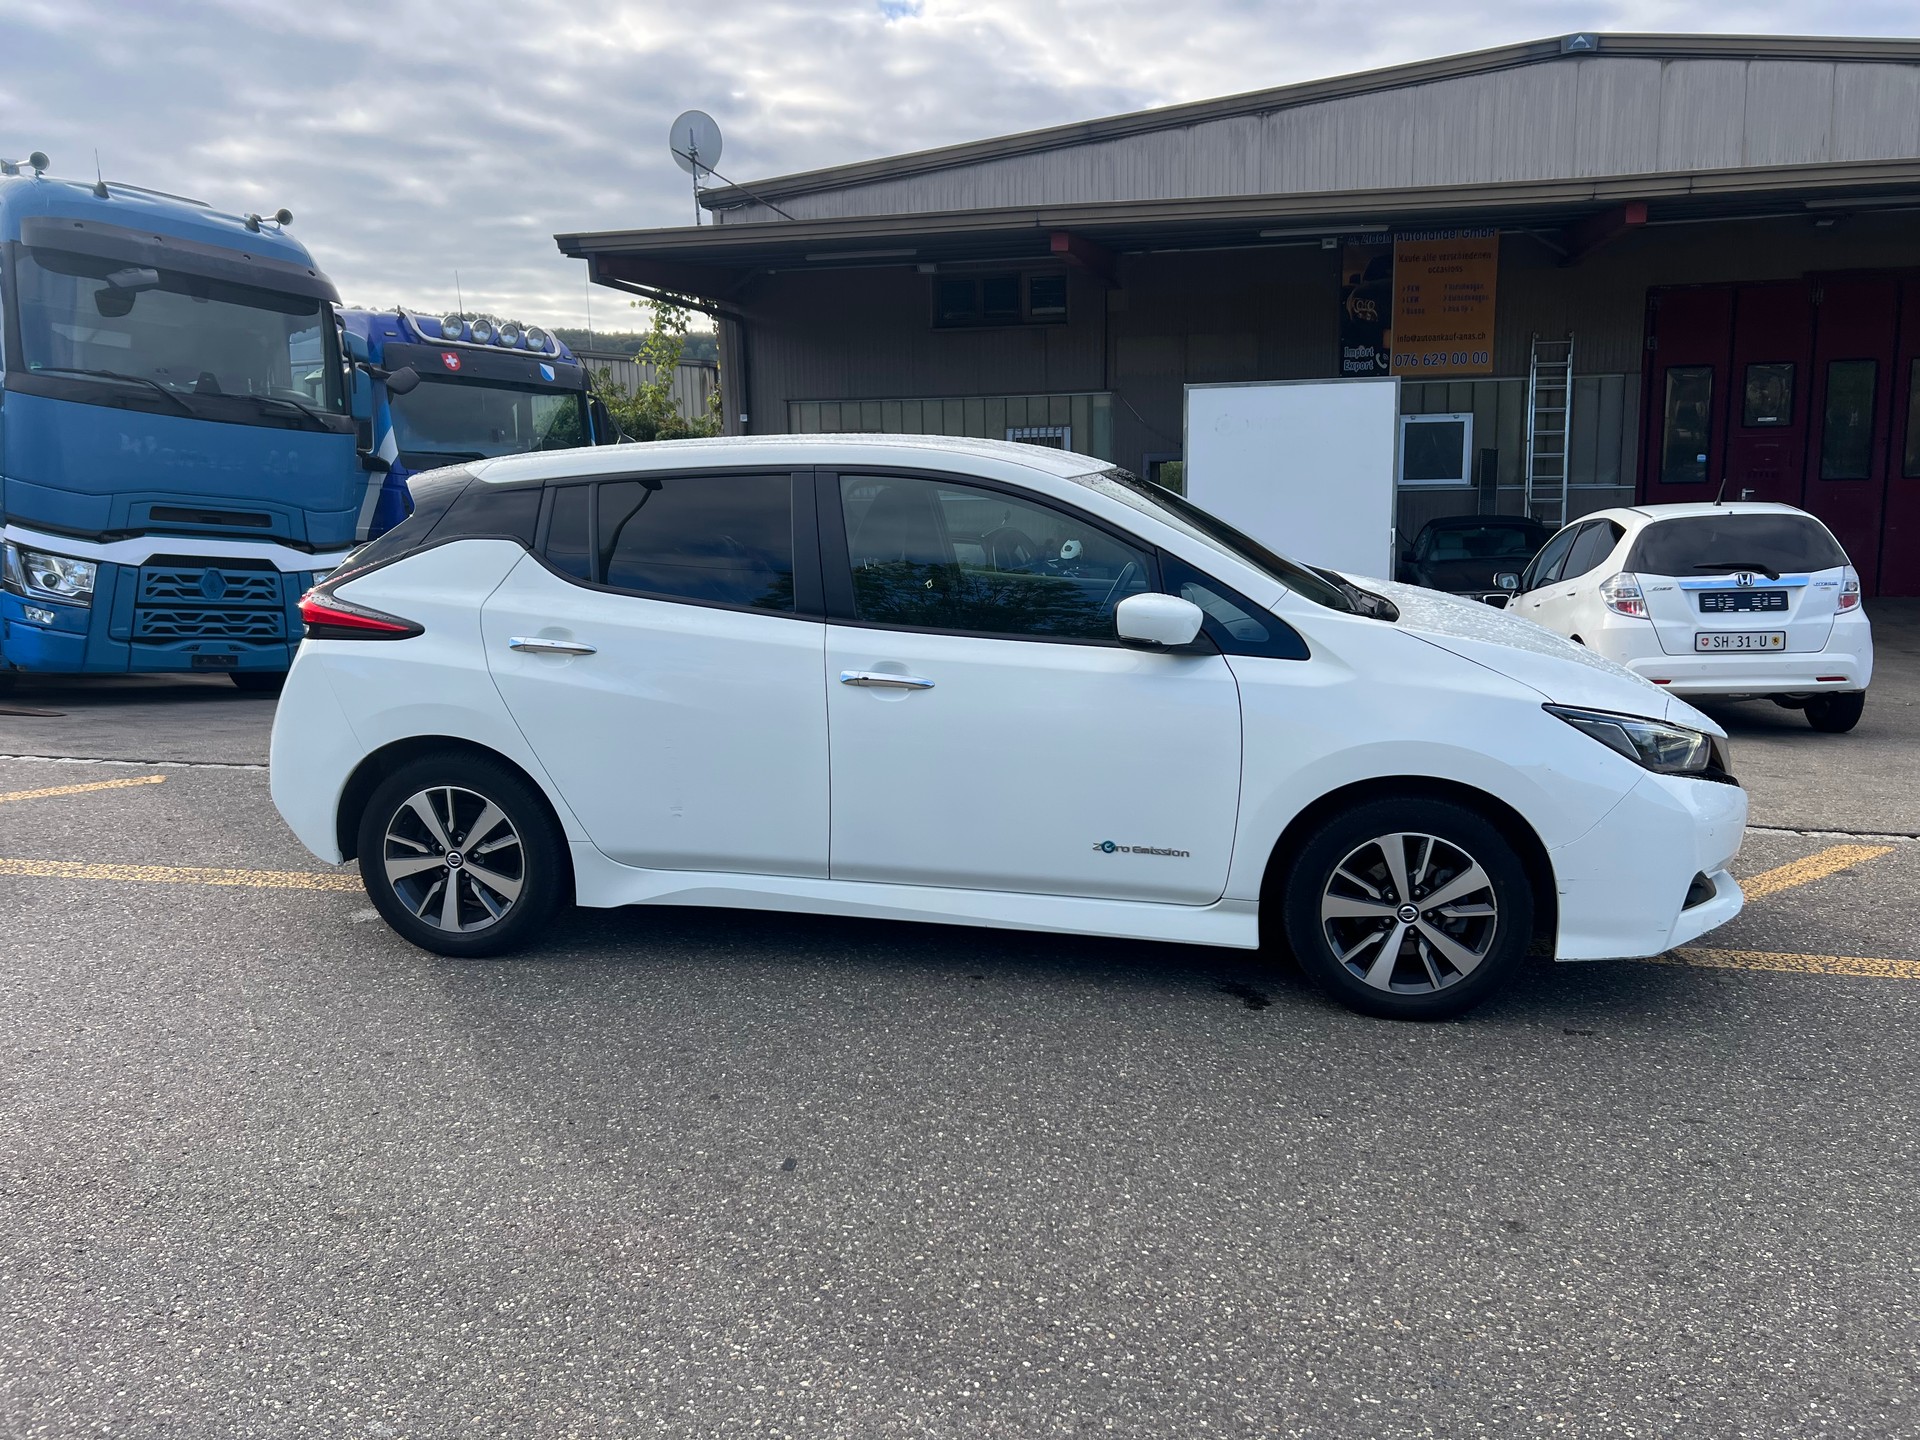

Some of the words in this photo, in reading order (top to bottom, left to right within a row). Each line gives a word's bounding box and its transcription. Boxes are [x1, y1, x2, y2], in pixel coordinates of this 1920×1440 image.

[1397, 332, 1486, 343] info@autoankauf-anas.ch
[1344, 345, 1375, 358] Import
[1344, 359, 1375, 372] Export
[1394, 353, 1419, 367] 076
[1423, 352, 1447, 366] 629
[1451, 351, 1468, 365] 00
[1472, 351, 1489, 364] 00
[1092, 840, 1130, 853] Zero
[1132, 846, 1190, 858] Emission
